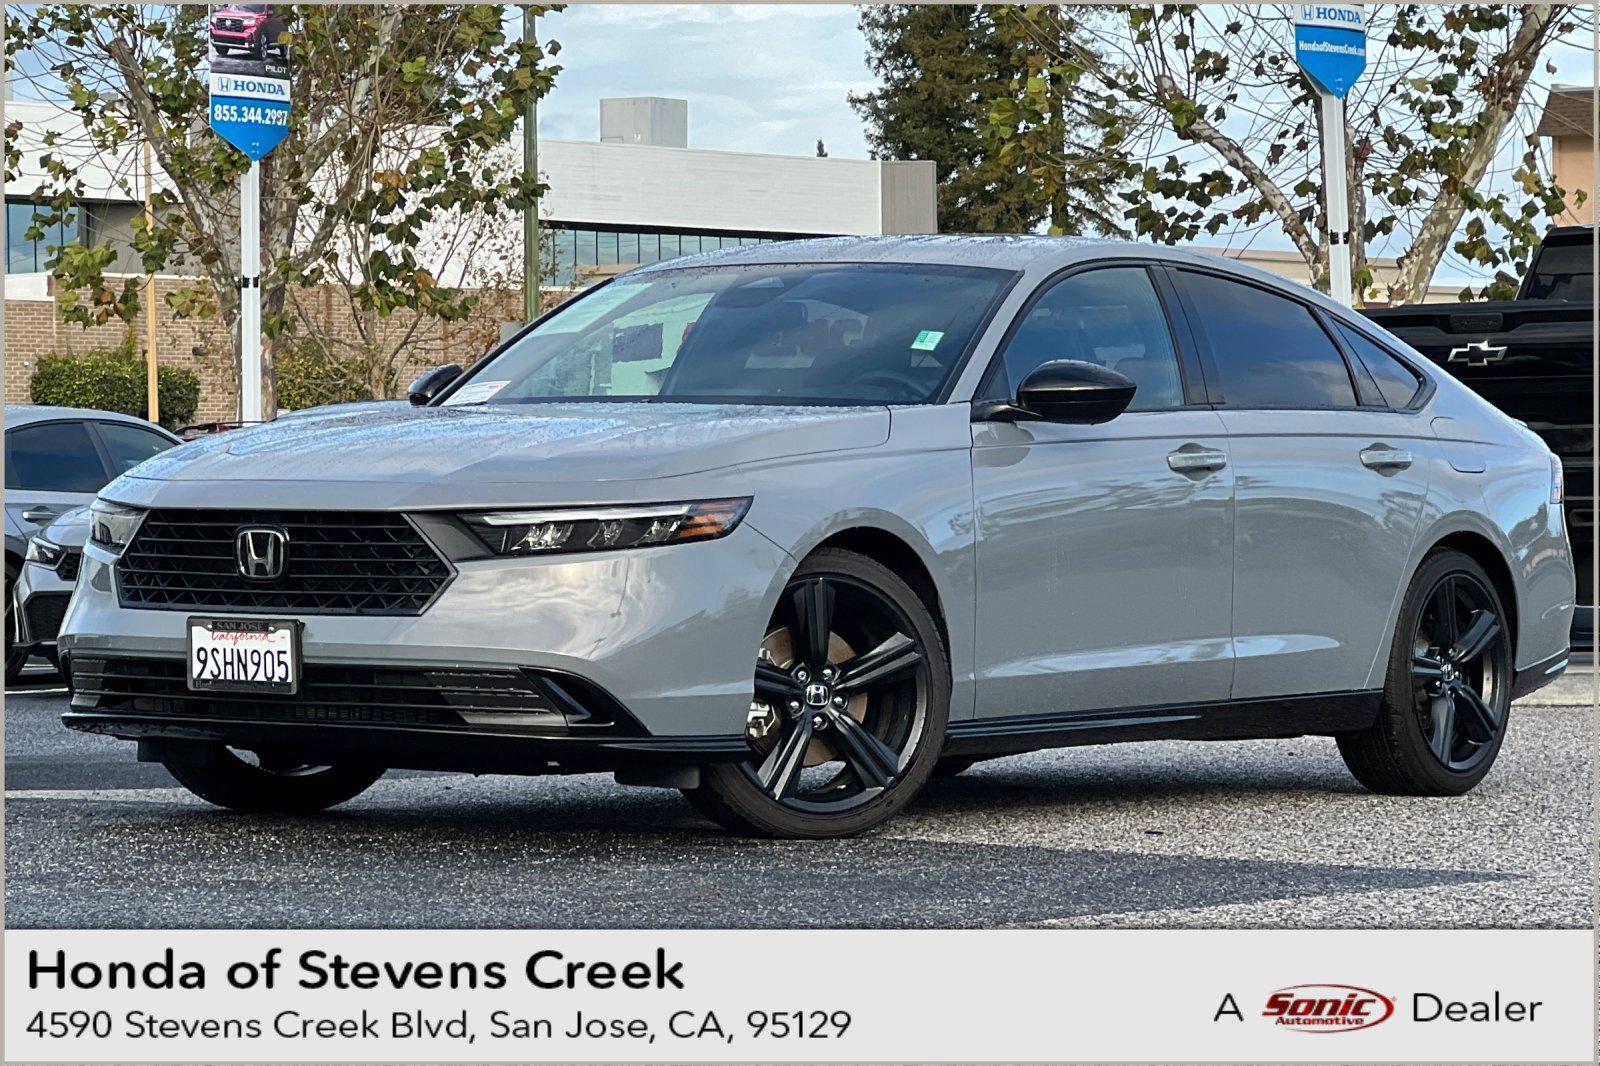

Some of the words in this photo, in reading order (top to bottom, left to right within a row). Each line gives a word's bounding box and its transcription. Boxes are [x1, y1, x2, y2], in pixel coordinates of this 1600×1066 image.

[1316, 7, 1361, 23] HONDA
[265, 65, 287, 73] PILOT
[233, 80, 285, 95] HONDA
[217, 622, 236, 630] SAN
[239, 622, 263, 631] JOSE
[211, 631, 276, 645] California
[196, 647, 289, 682] 9SHN905
